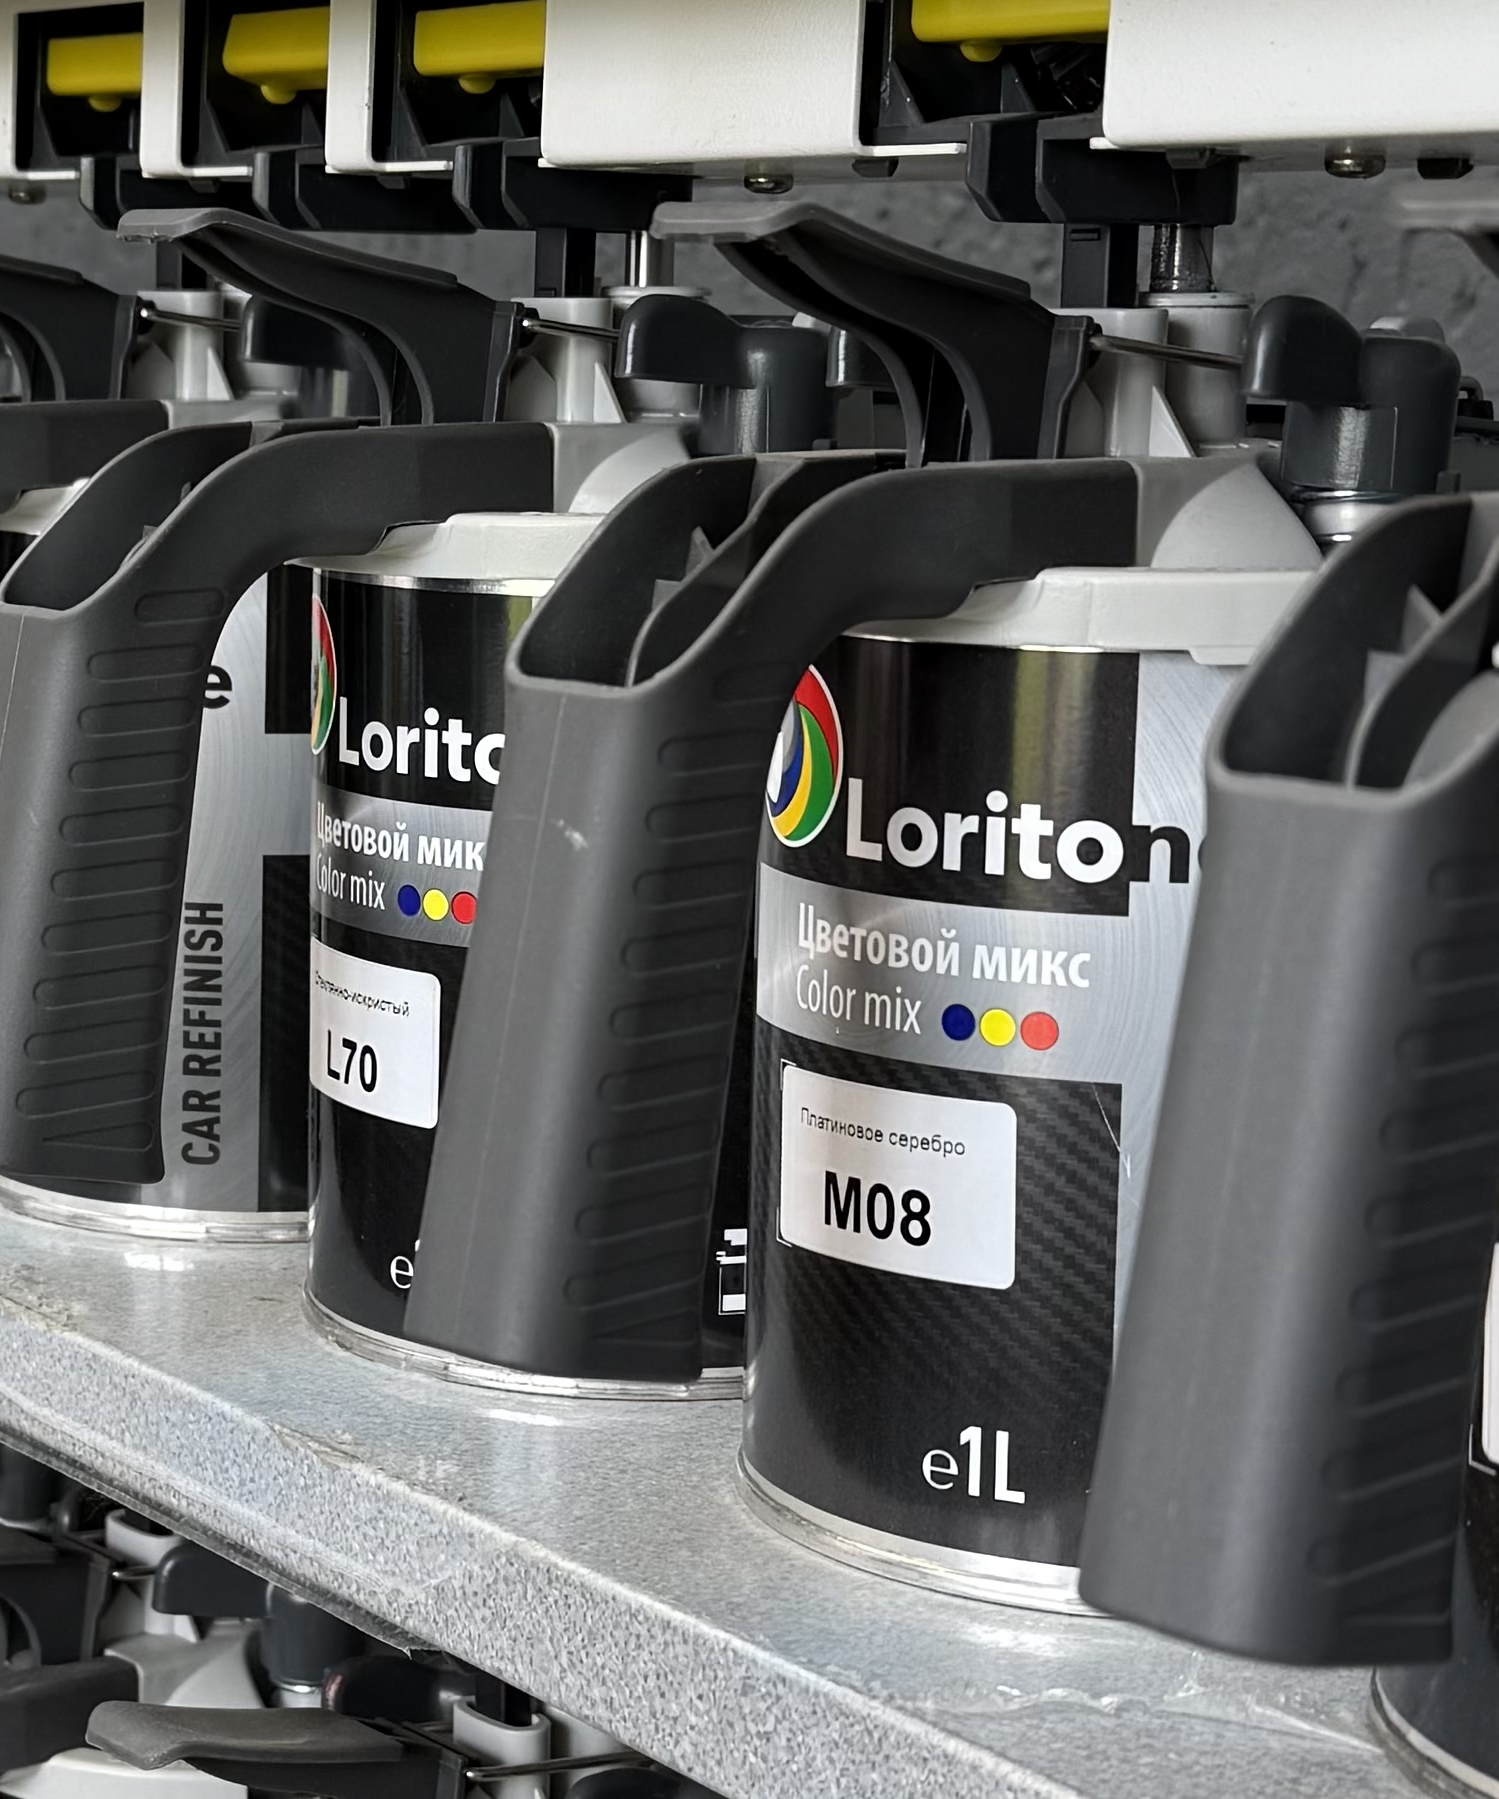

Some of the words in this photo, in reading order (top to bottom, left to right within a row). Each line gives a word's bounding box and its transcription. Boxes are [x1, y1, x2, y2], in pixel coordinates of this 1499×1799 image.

[338, 696, 506, 786] Lorito
[316, 801, 409, 862] Цветовой
[417, 835, 486, 872] мик
[845, 777, 1204, 884] Loriton
[316, 853, 346, 900] Color
[350, 870, 386, 911] mix
[798, 902, 960, 977] Цветовой
[972, 944, 1092, 988] микс
[182, 902, 224, 1077] REFINISH
[796, 964, 856, 1022] Color
[864, 986, 922, 1035] mix
[327, 1029, 378, 1093] L70
[181, 1090, 222, 1166] CAR
[801, 1107, 884, 1142] Платиновое
[889, 1131, 966, 1157] серебро
[824, 1170, 932, 1247] M08
